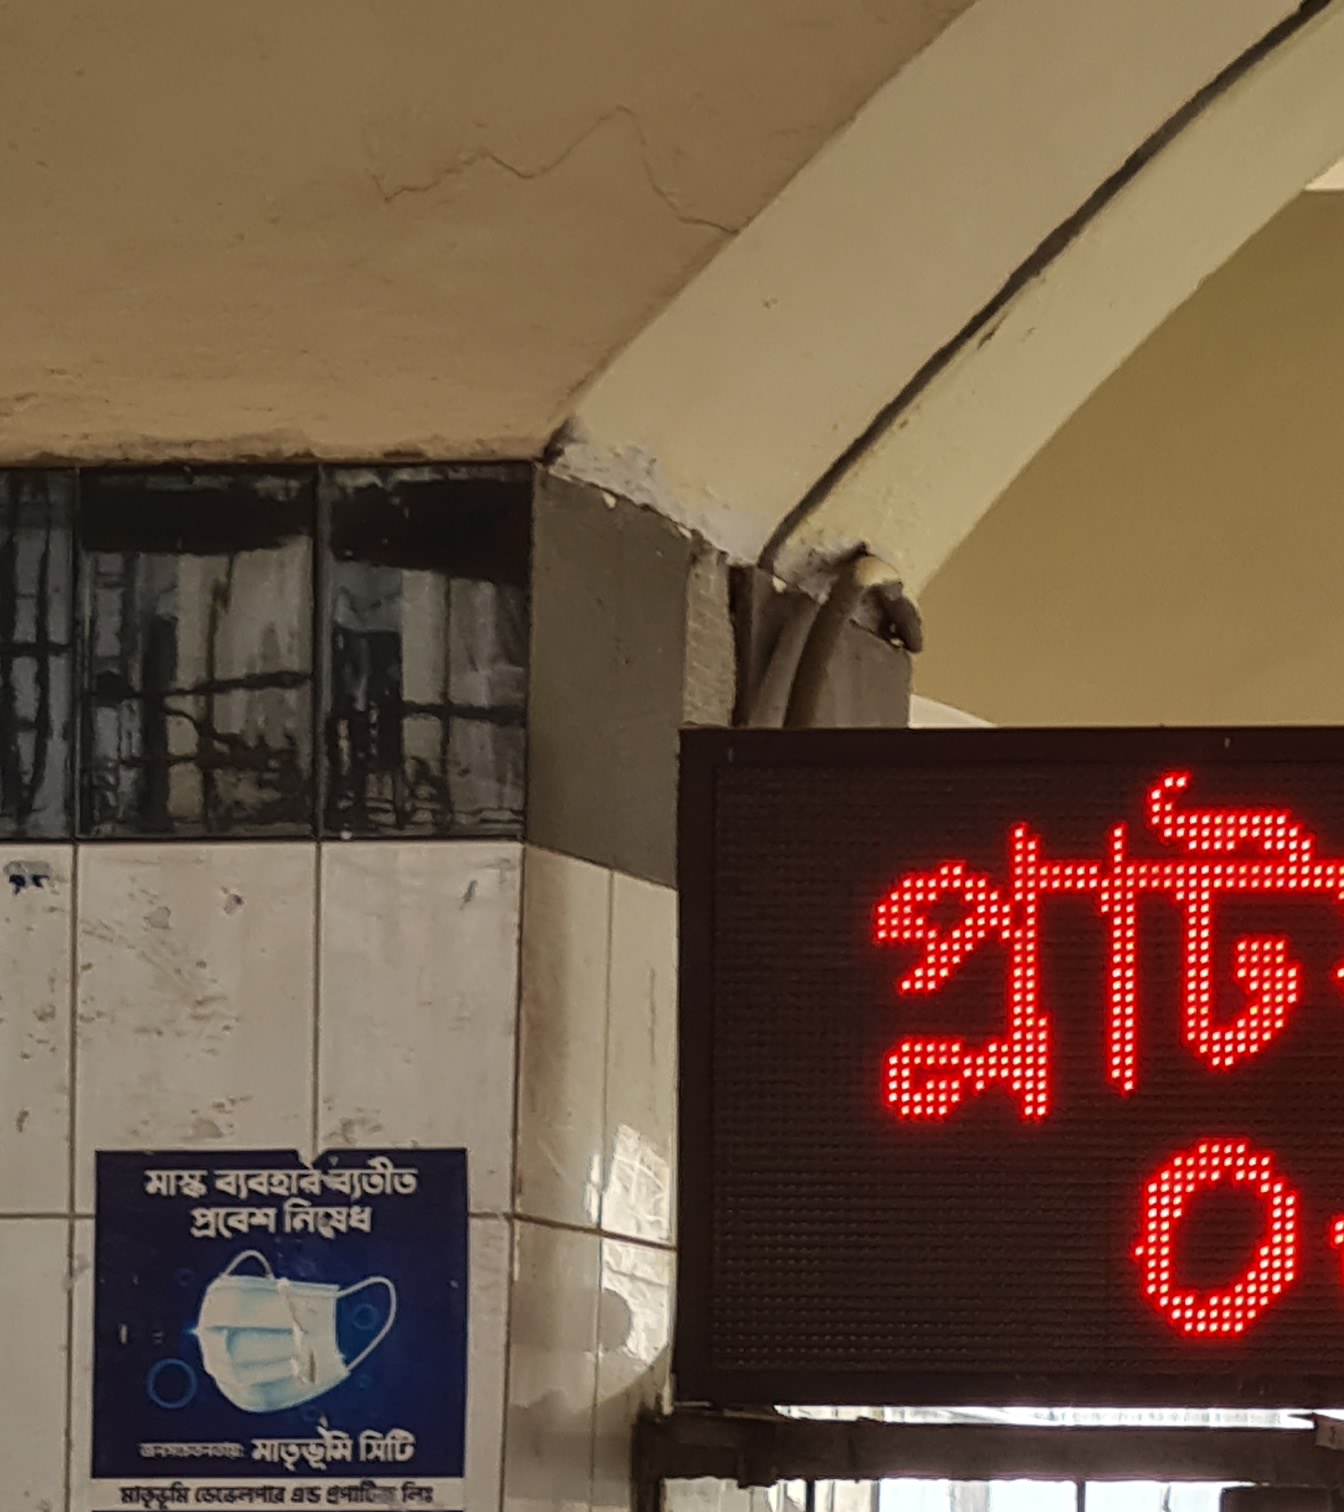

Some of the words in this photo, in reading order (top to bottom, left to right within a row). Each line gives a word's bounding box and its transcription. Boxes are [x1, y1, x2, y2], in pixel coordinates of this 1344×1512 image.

[144, 1169, 208, 1198] মাস্ক
[213, 1168, 322, 1200] ব্যবহার
[326, 1156, 419, 1201] ব্যতীত
[189, 1206, 278, 1238] প্রবেশ
[283, 1197, 373, 1240] নিষেধ
[358, 1428, 416, 1463] সিটি
